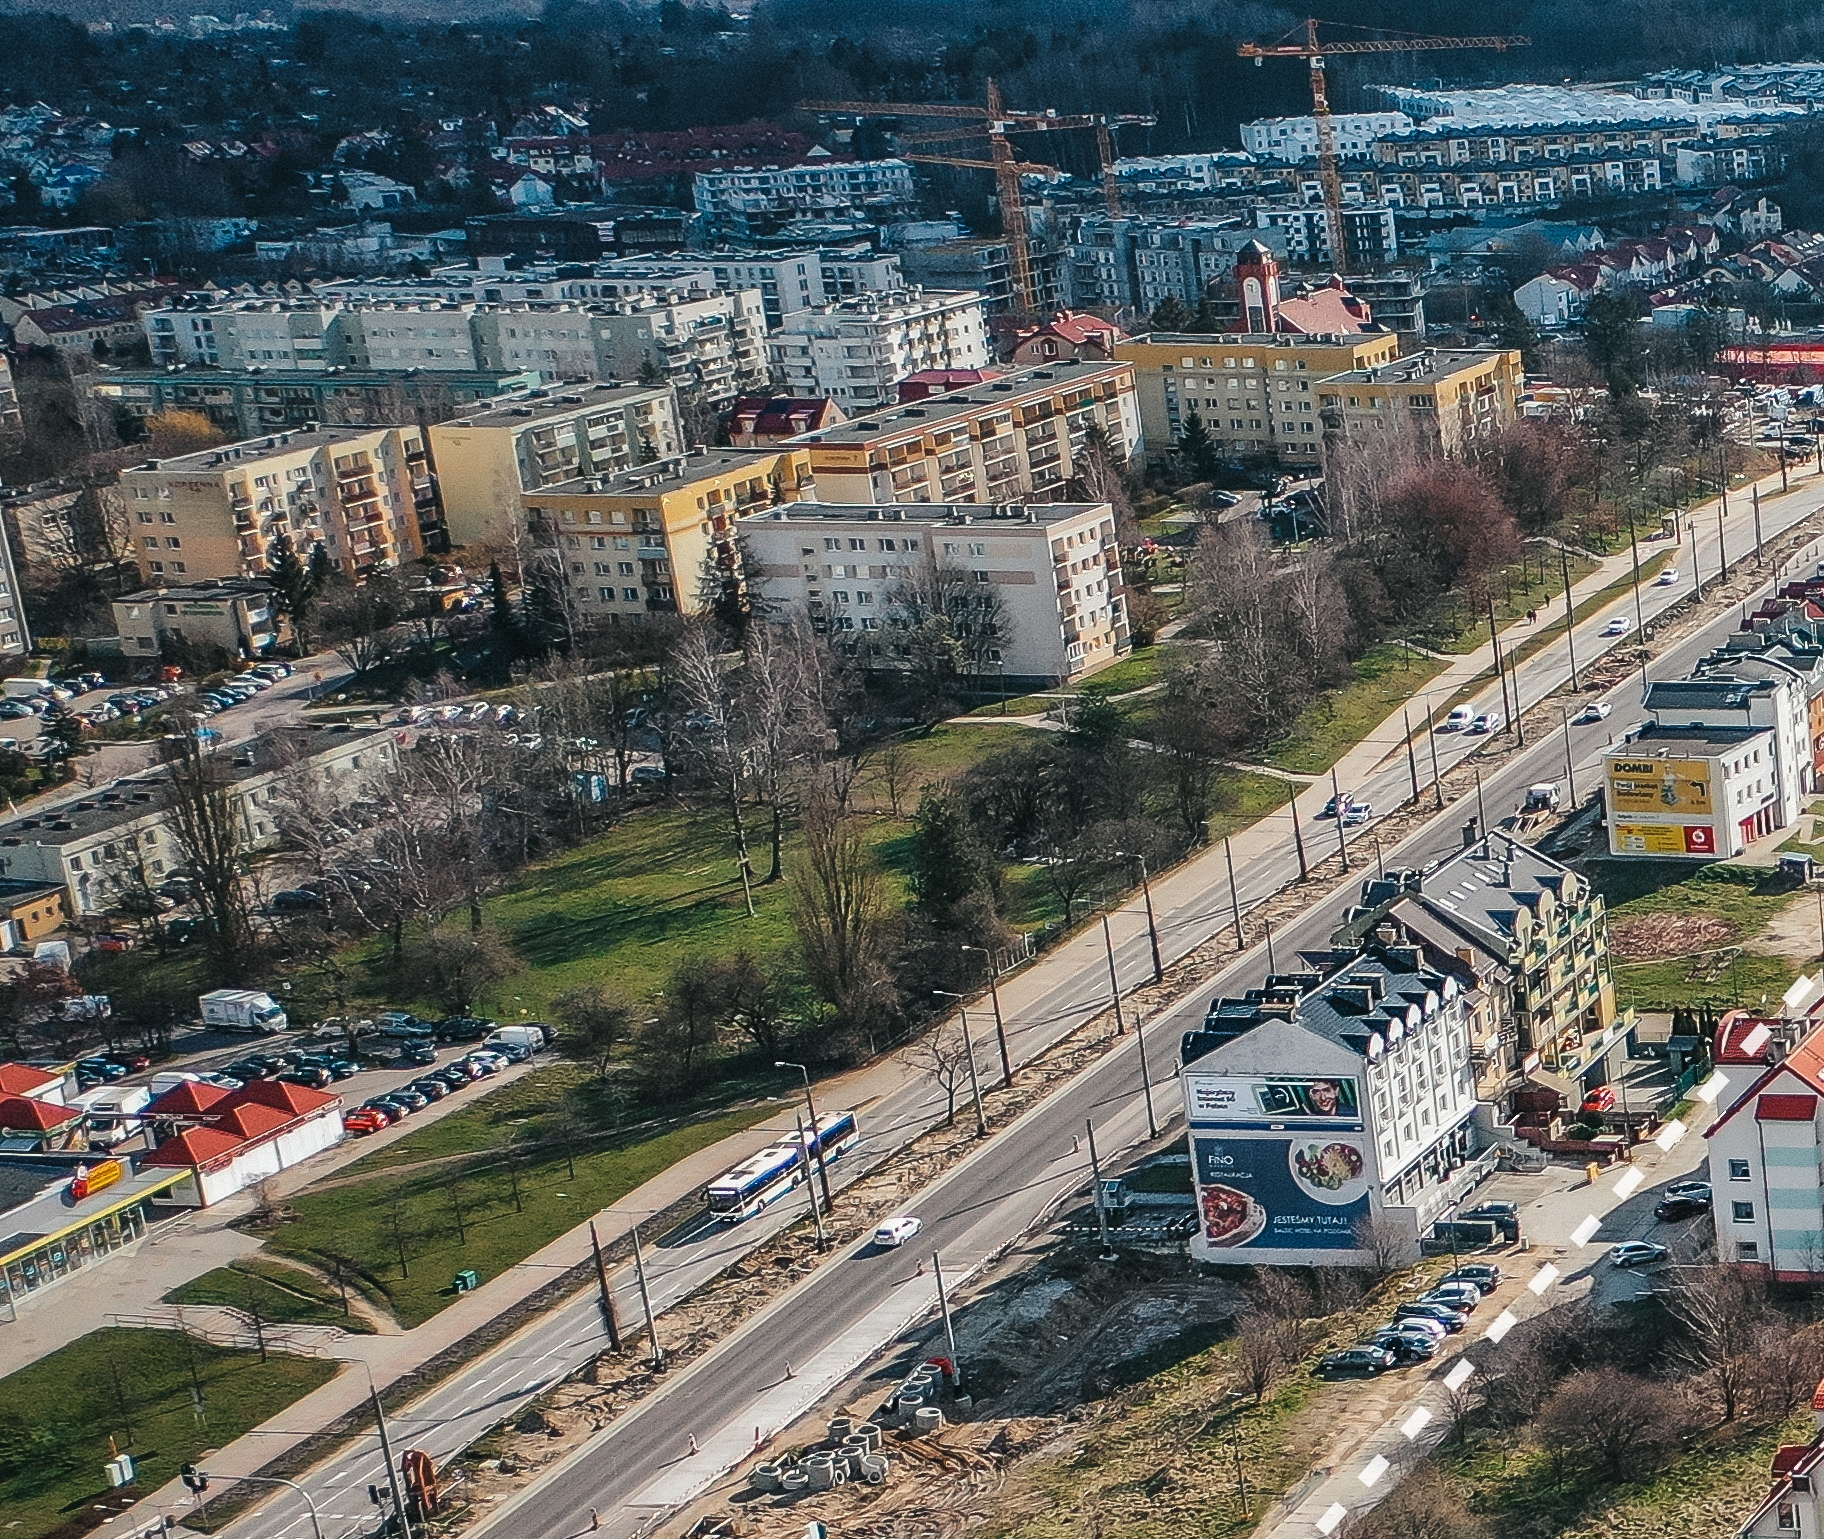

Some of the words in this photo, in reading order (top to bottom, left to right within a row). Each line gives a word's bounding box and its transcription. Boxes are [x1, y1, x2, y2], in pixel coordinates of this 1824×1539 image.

[1614, 763, 1653, 773] DOMBI
[1273, 1215, 1315, 1224] JESTEŚMY
[1317, 1215, 1348, 1225] TUTAJ!
